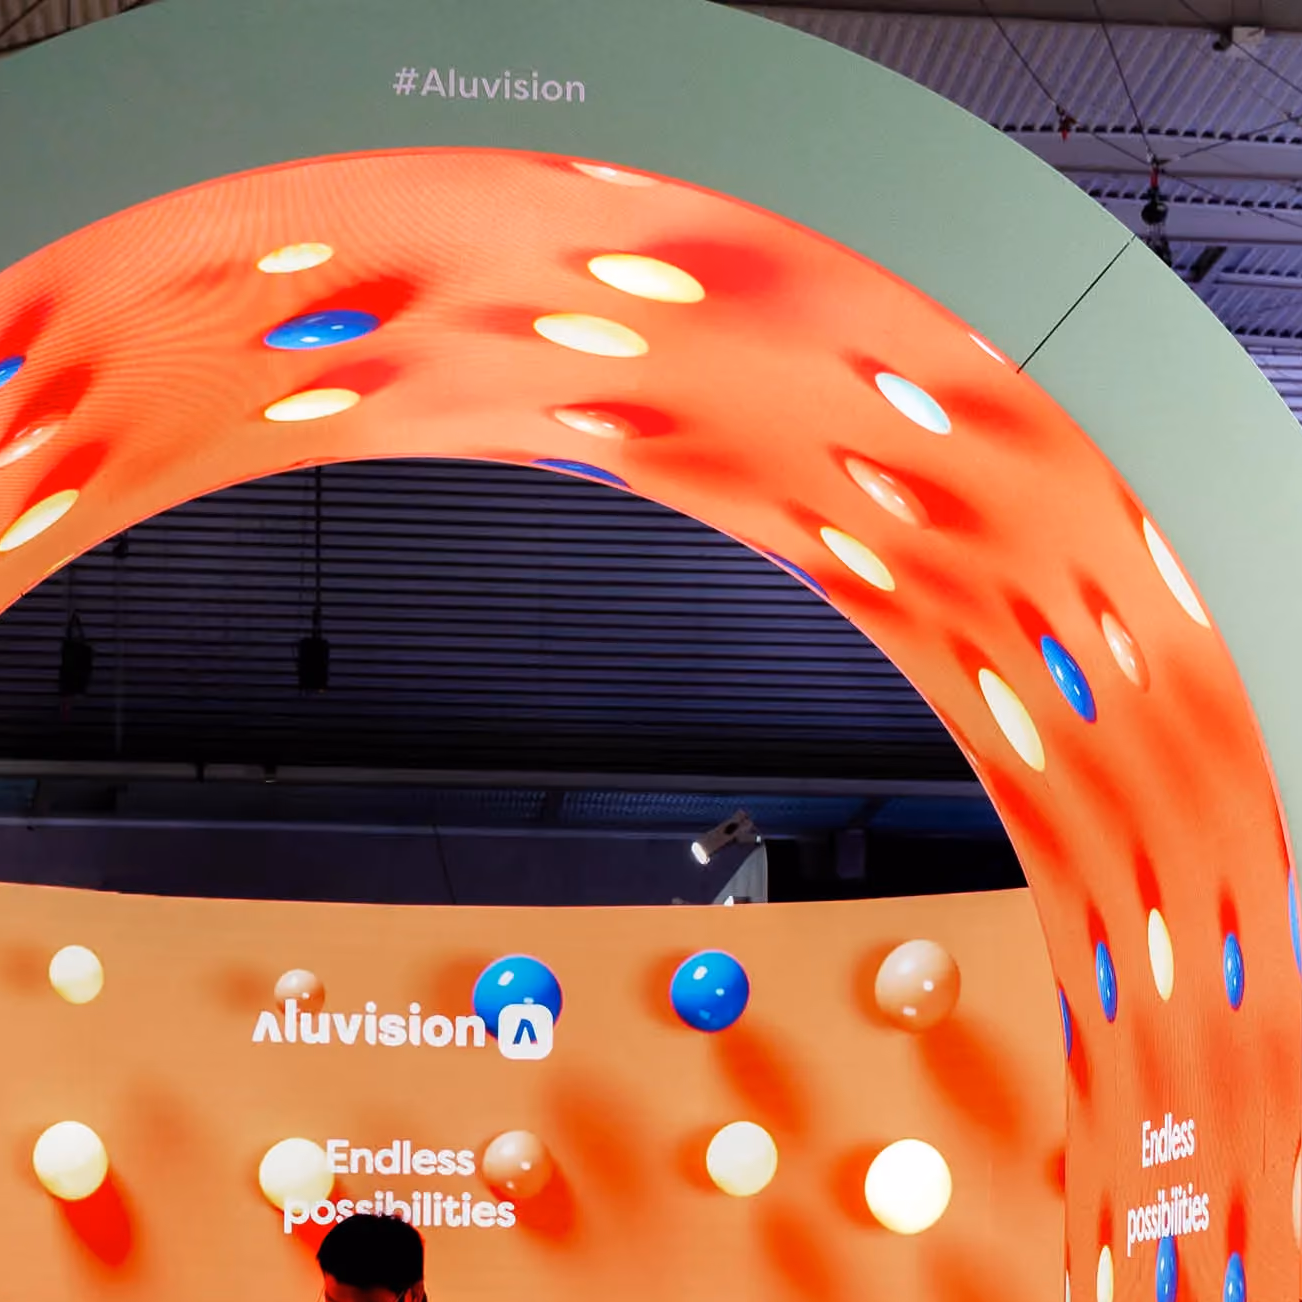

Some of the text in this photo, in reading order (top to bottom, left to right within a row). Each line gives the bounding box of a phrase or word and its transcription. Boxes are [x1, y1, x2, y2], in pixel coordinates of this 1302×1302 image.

[392, 67, 586, 102] #Aluvision
[325, 1139, 475, 1176] Endless
[1141, 1112, 1195, 1168] Endless
[283, 1190, 517, 1234] possibilities
[1127, 1182, 1210, 1258] possibilities
